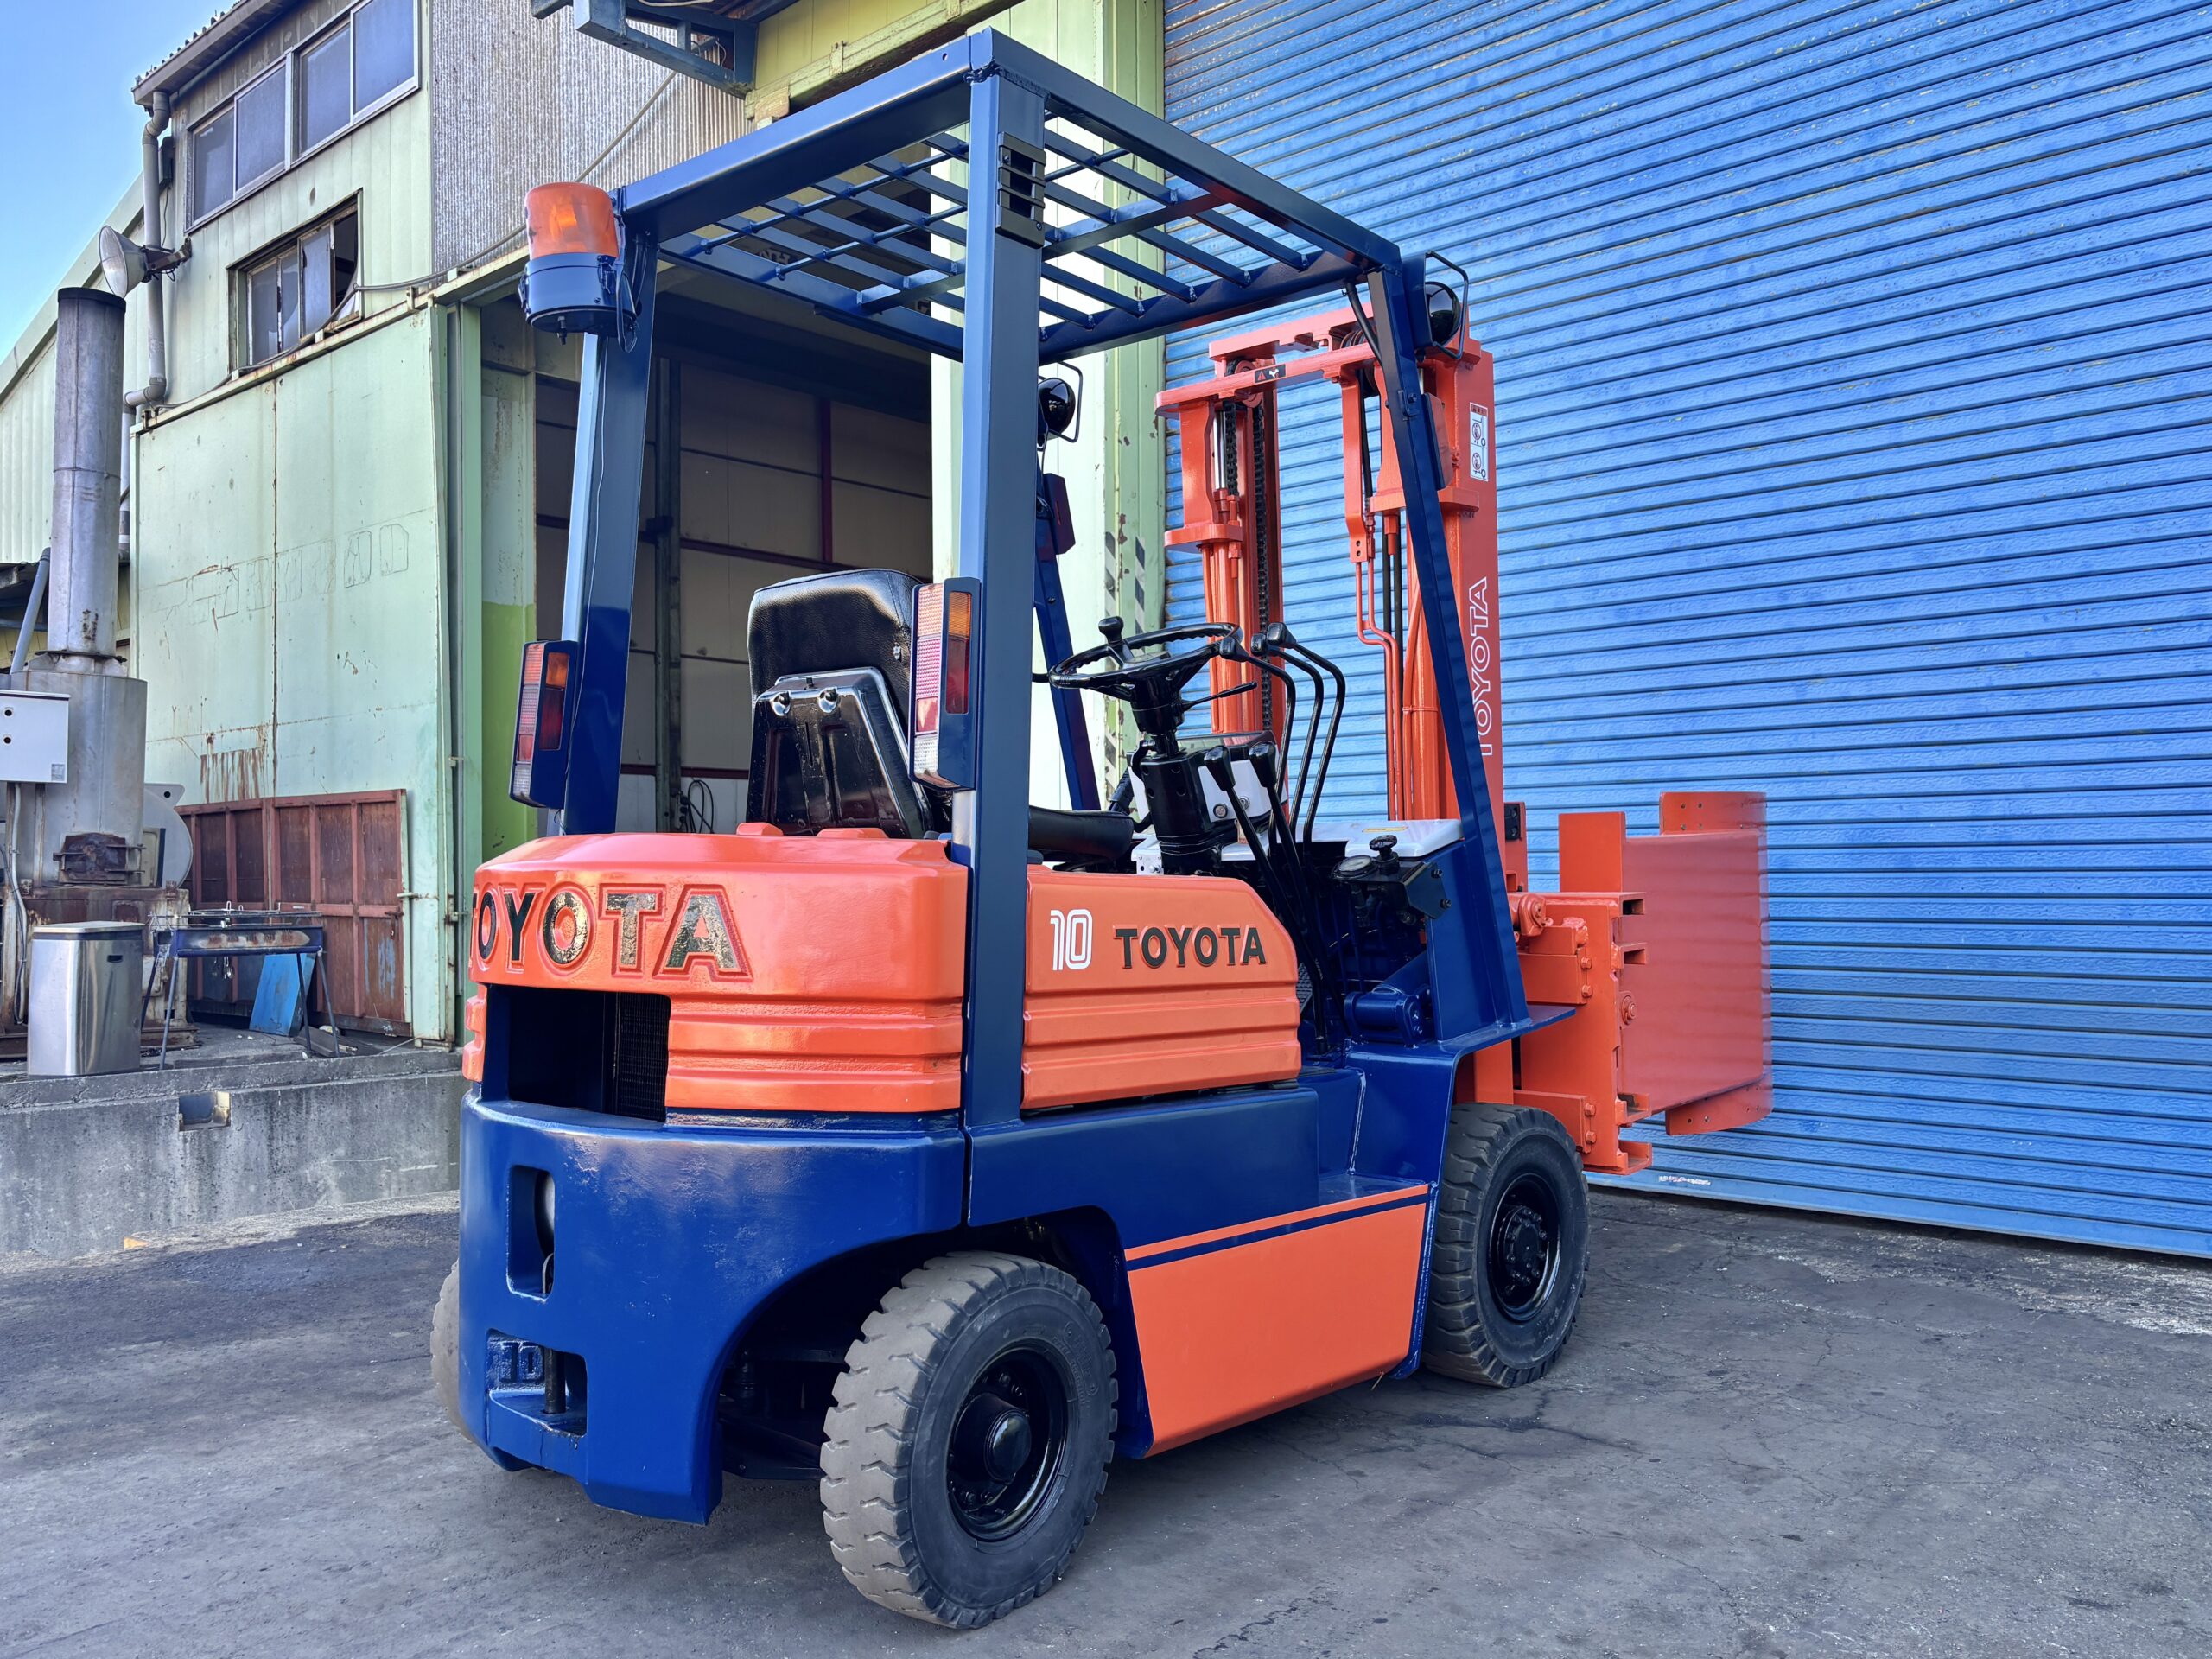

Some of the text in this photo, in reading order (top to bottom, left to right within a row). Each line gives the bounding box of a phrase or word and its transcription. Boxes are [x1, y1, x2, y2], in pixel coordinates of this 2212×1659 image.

[472, 888, 745, 971] OYOTA
[1050, 908, 1093, 971] 10
[1114, 925, 1267, 969] TOYOTA
